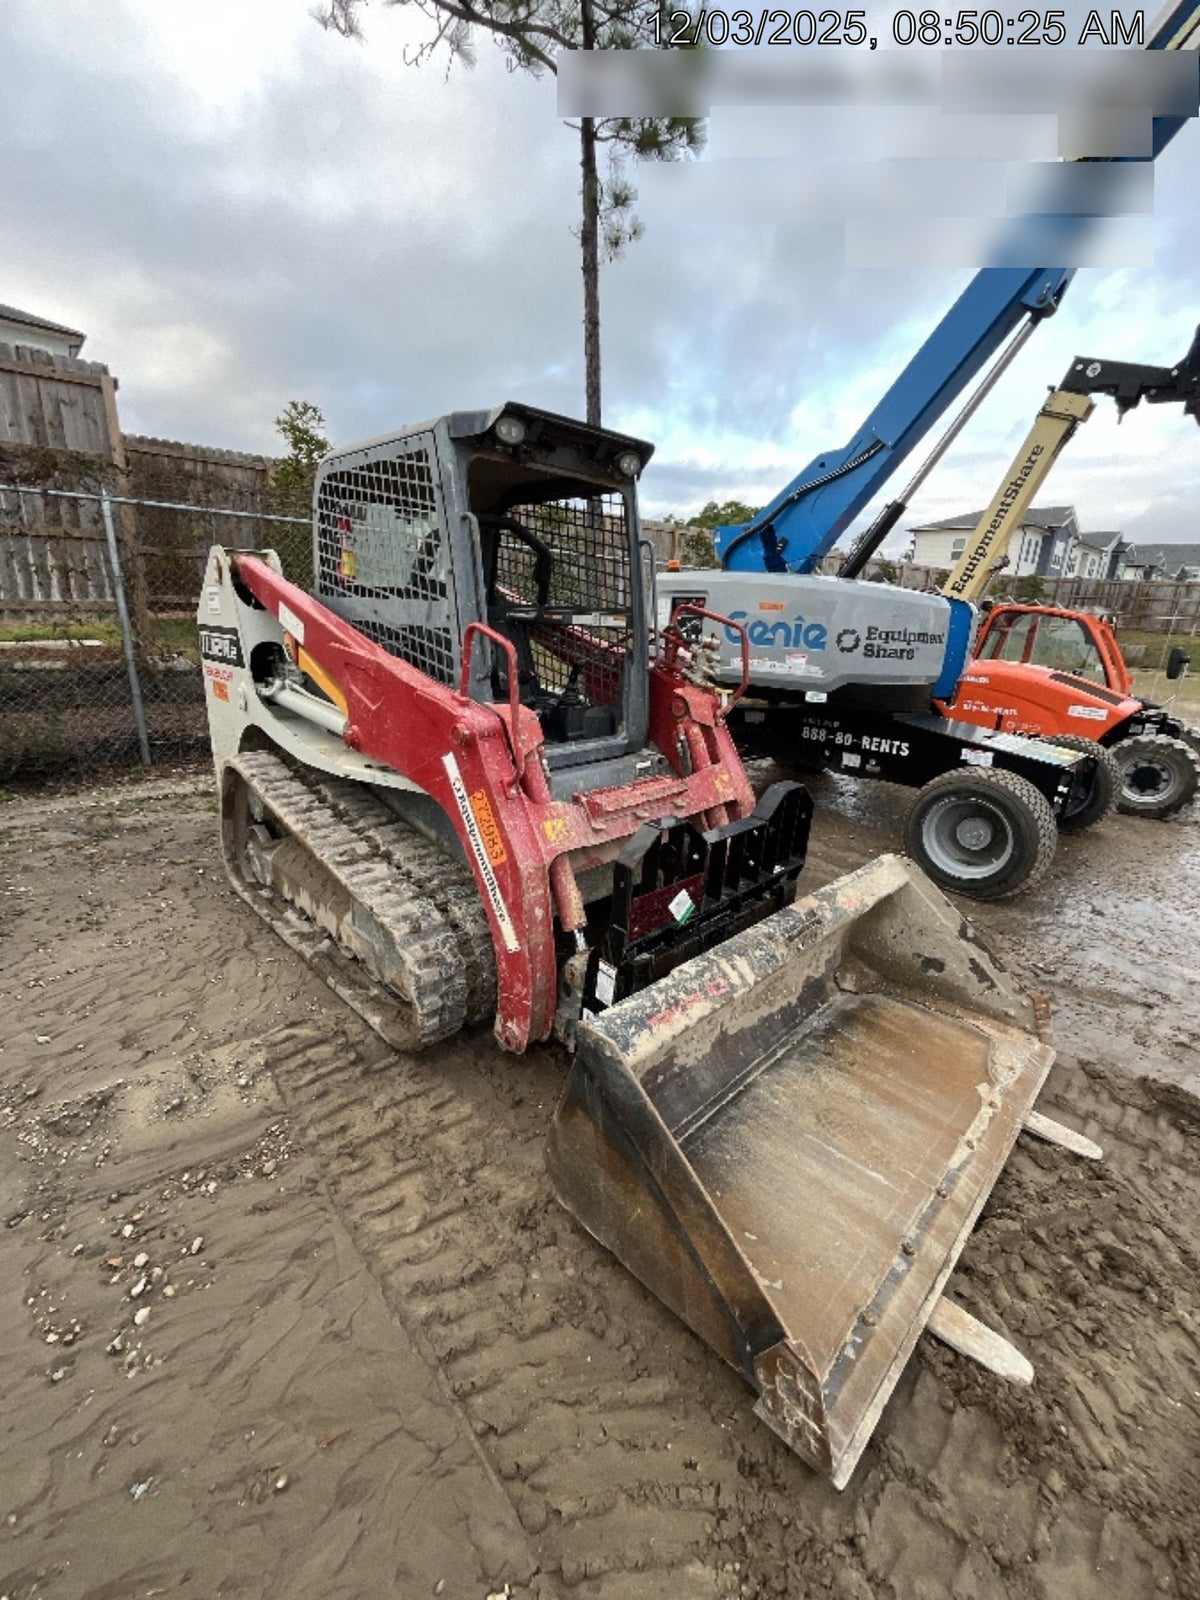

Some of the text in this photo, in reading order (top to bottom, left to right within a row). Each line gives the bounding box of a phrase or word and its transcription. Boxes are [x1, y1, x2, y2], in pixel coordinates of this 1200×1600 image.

[950, 444, 1044, 594] EquipmentShare
[724, 610, 828, 652] Genie
[863, 643, 915, 660] Share
[801, 726, 910, 756] 888-80-RENTS
